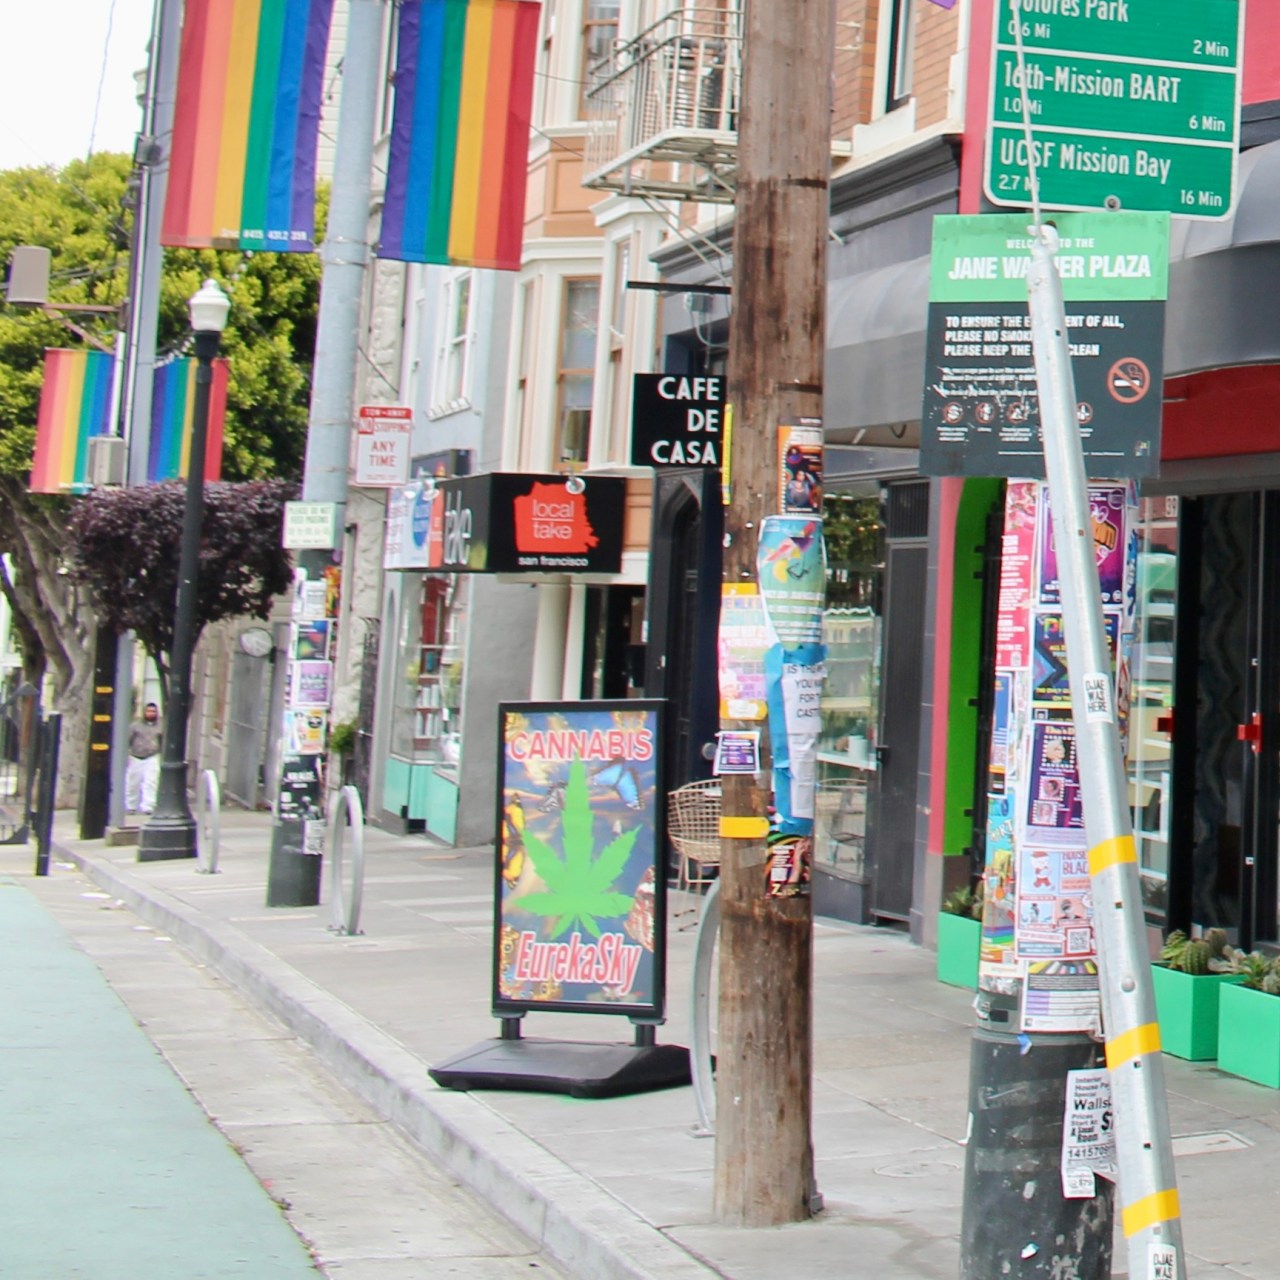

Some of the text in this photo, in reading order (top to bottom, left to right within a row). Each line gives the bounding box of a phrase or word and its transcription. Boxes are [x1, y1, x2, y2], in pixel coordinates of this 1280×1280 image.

[1034, 23, 1050, 39] Mi
[1193, 40, 1203, 55] 2
[1205, 41, 1229, 57] Min
[1130, 74, 1181, 104] BART
[1189, 115, 1199, 130] 6
[1202, 116, 1226, 132] Min
[1001, 138, 1172, 184] UCSF Mission Bay
[999, 175, 1021, 190] 2.7
[1180, 189, 1196, 205] 16
[1198, 191, 1222, 207] Min
[1060, 238, 1072, 249] TO
[1075, 238, 1095, 248] THE
[948, 256, 998, 280] JANE
[1090, 255, 1151, 277] PLAZA
[946, 317, 959, 328] TO
[961, 317, 1001, 328] ENSURE
[1003, 317, 1022, 327] THE
[1086, 317, 1100, 327] OF
[1102, 317, 1124, 329] ALL,
[945, 331, 982, 342] PLEASE
[984, 331, 999, 342] NO
[944, 345, 982, 357] PLEASE
[983, 345, 1009, 356] KEEP
[1012, 345, 1031, 356] THE
[658, 377, 720, 401] CAFE
[687, 409, 719, 433] DE
[371, 441, 396, 452] ANY
[651, 440, 717, 465] CASA
[370, 454, 397, 467] TIME
[532, 499, 575, 518] local
[532, 521, 572, 540] take
[518, 554, 588, 567] san francisco
[1089, 691, 1104, 701] WAS
[1088, 701, 1107, 712] HERE
[508, 730, 653, 762] CANNABIS
[515, 931, 643, 994] EurekaSky
